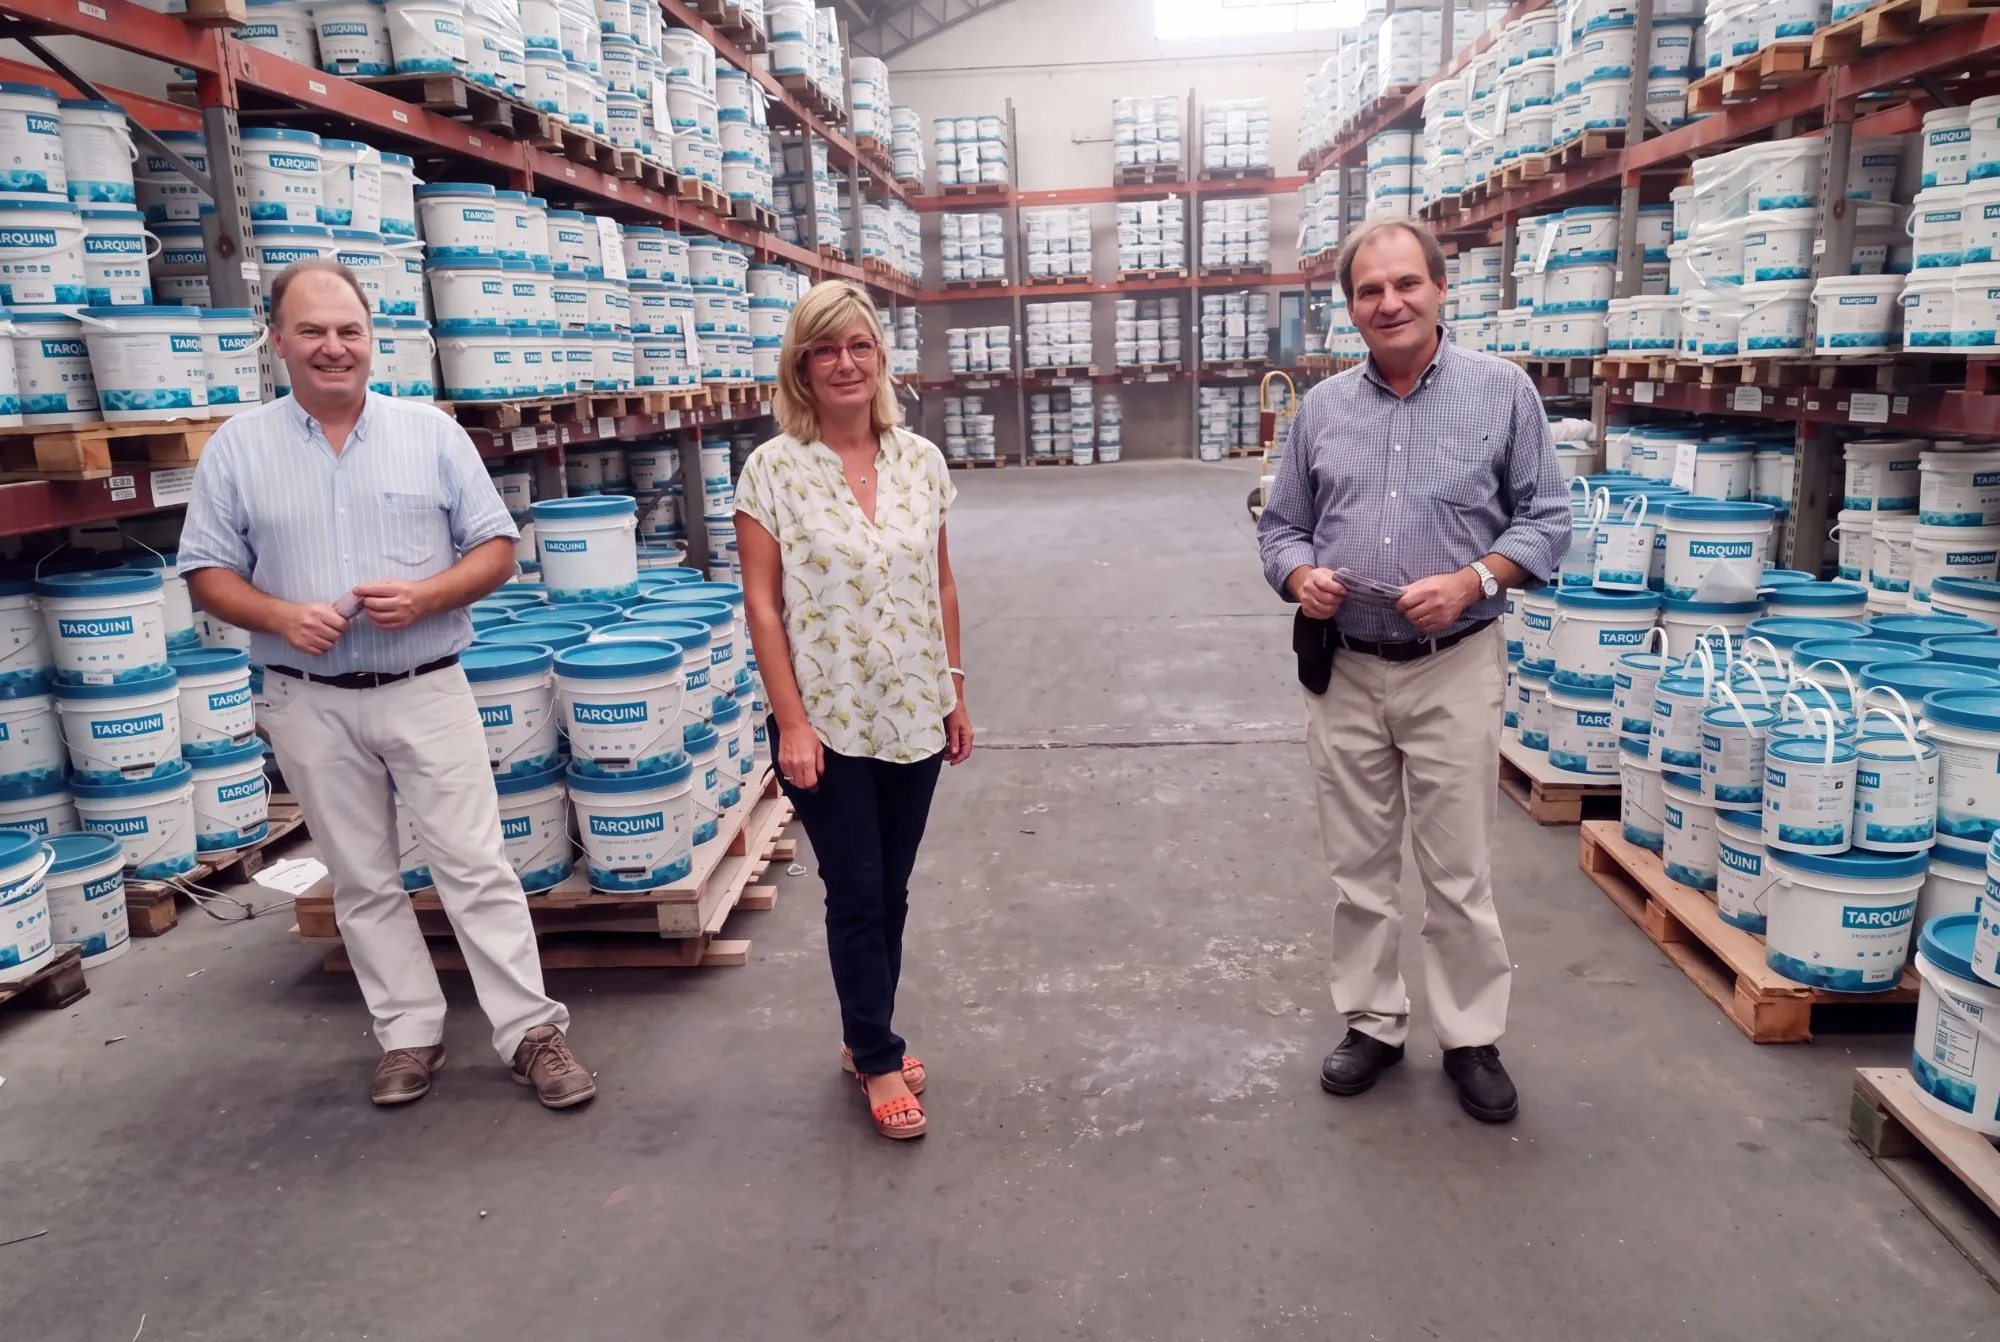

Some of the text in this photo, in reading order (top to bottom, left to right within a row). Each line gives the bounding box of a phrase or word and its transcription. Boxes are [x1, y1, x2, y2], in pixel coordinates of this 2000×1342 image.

[324, 24, 366, 35] TARQUINI
[30, 119, 58, 134] TARQ
[1, 233, 54, 248] RQUINI
[87, 240, 141, 252] TARQUINI
[339, 256, 381, 267] TARQUINI
[174, 340, 200, 351] TARQ
[546, 542, 584, 551] TARQUINI
[1692, 545, 1750, 557] TARQUINI
[62, 621, 130, 635] TARQUINI
[576, 707, 643, 721] TARQUINI
[1579, 715, 1611, 725] TARQ
[95, 717, 160, 734] TARQUINI
[87, 820, 144, 834] TARQUINI
[592, 817, 660, 833] TARQUINI
